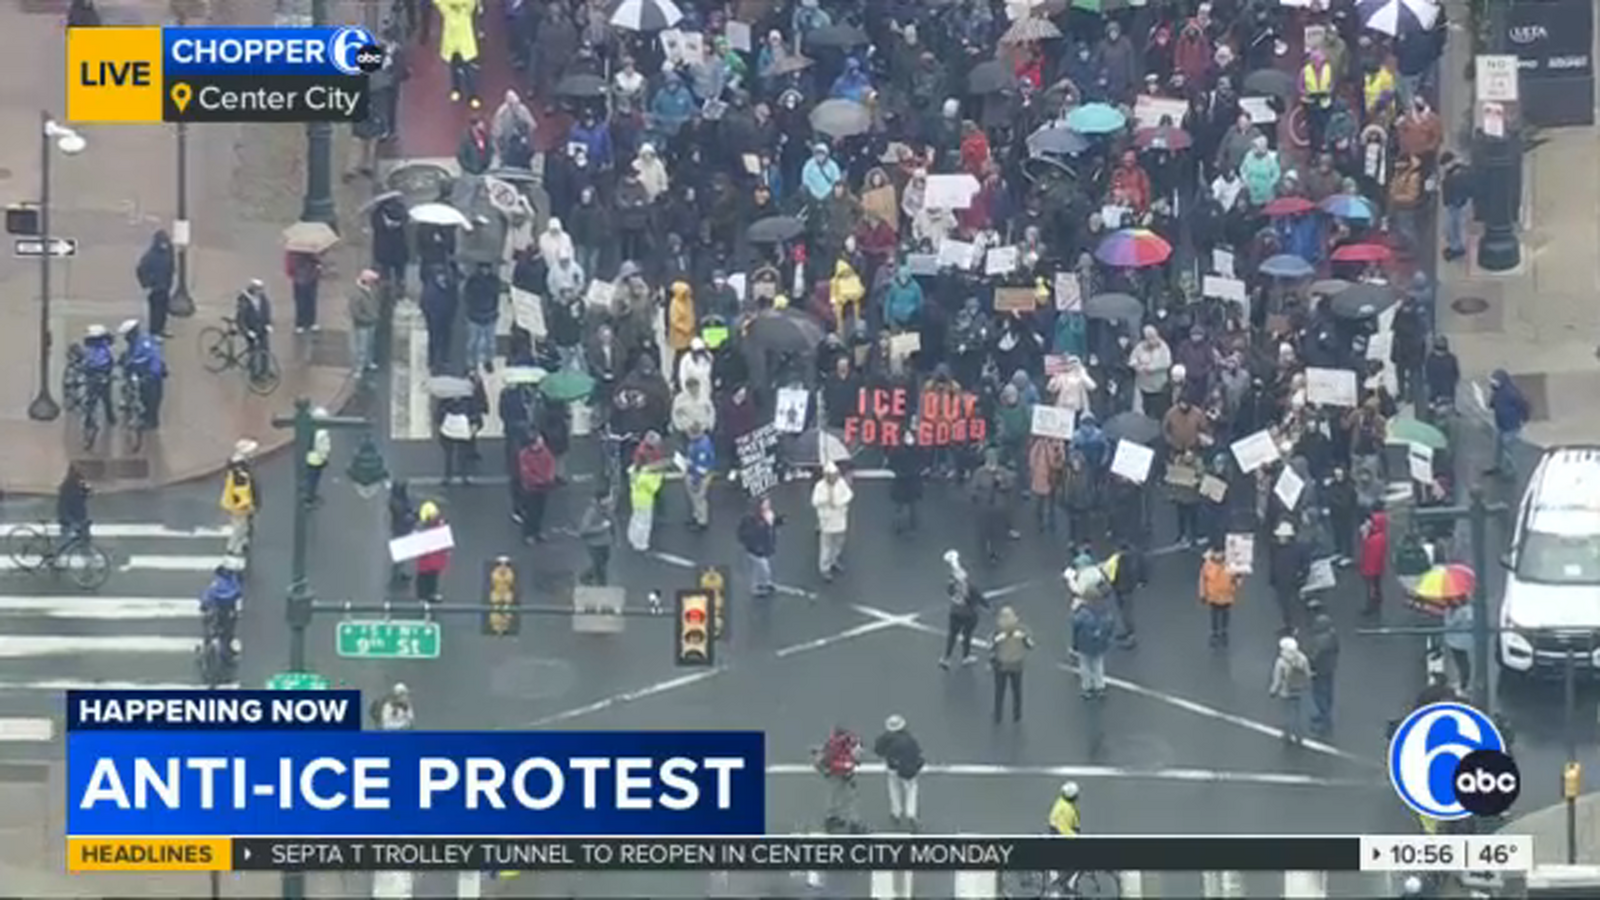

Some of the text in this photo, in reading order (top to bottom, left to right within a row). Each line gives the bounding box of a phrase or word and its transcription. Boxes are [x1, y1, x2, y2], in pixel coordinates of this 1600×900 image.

[858, 387, 978, 421] ICE OUT
[844, 416, 986, 446] FOR GOOD
[357, 638, 419, 654] 9th St
